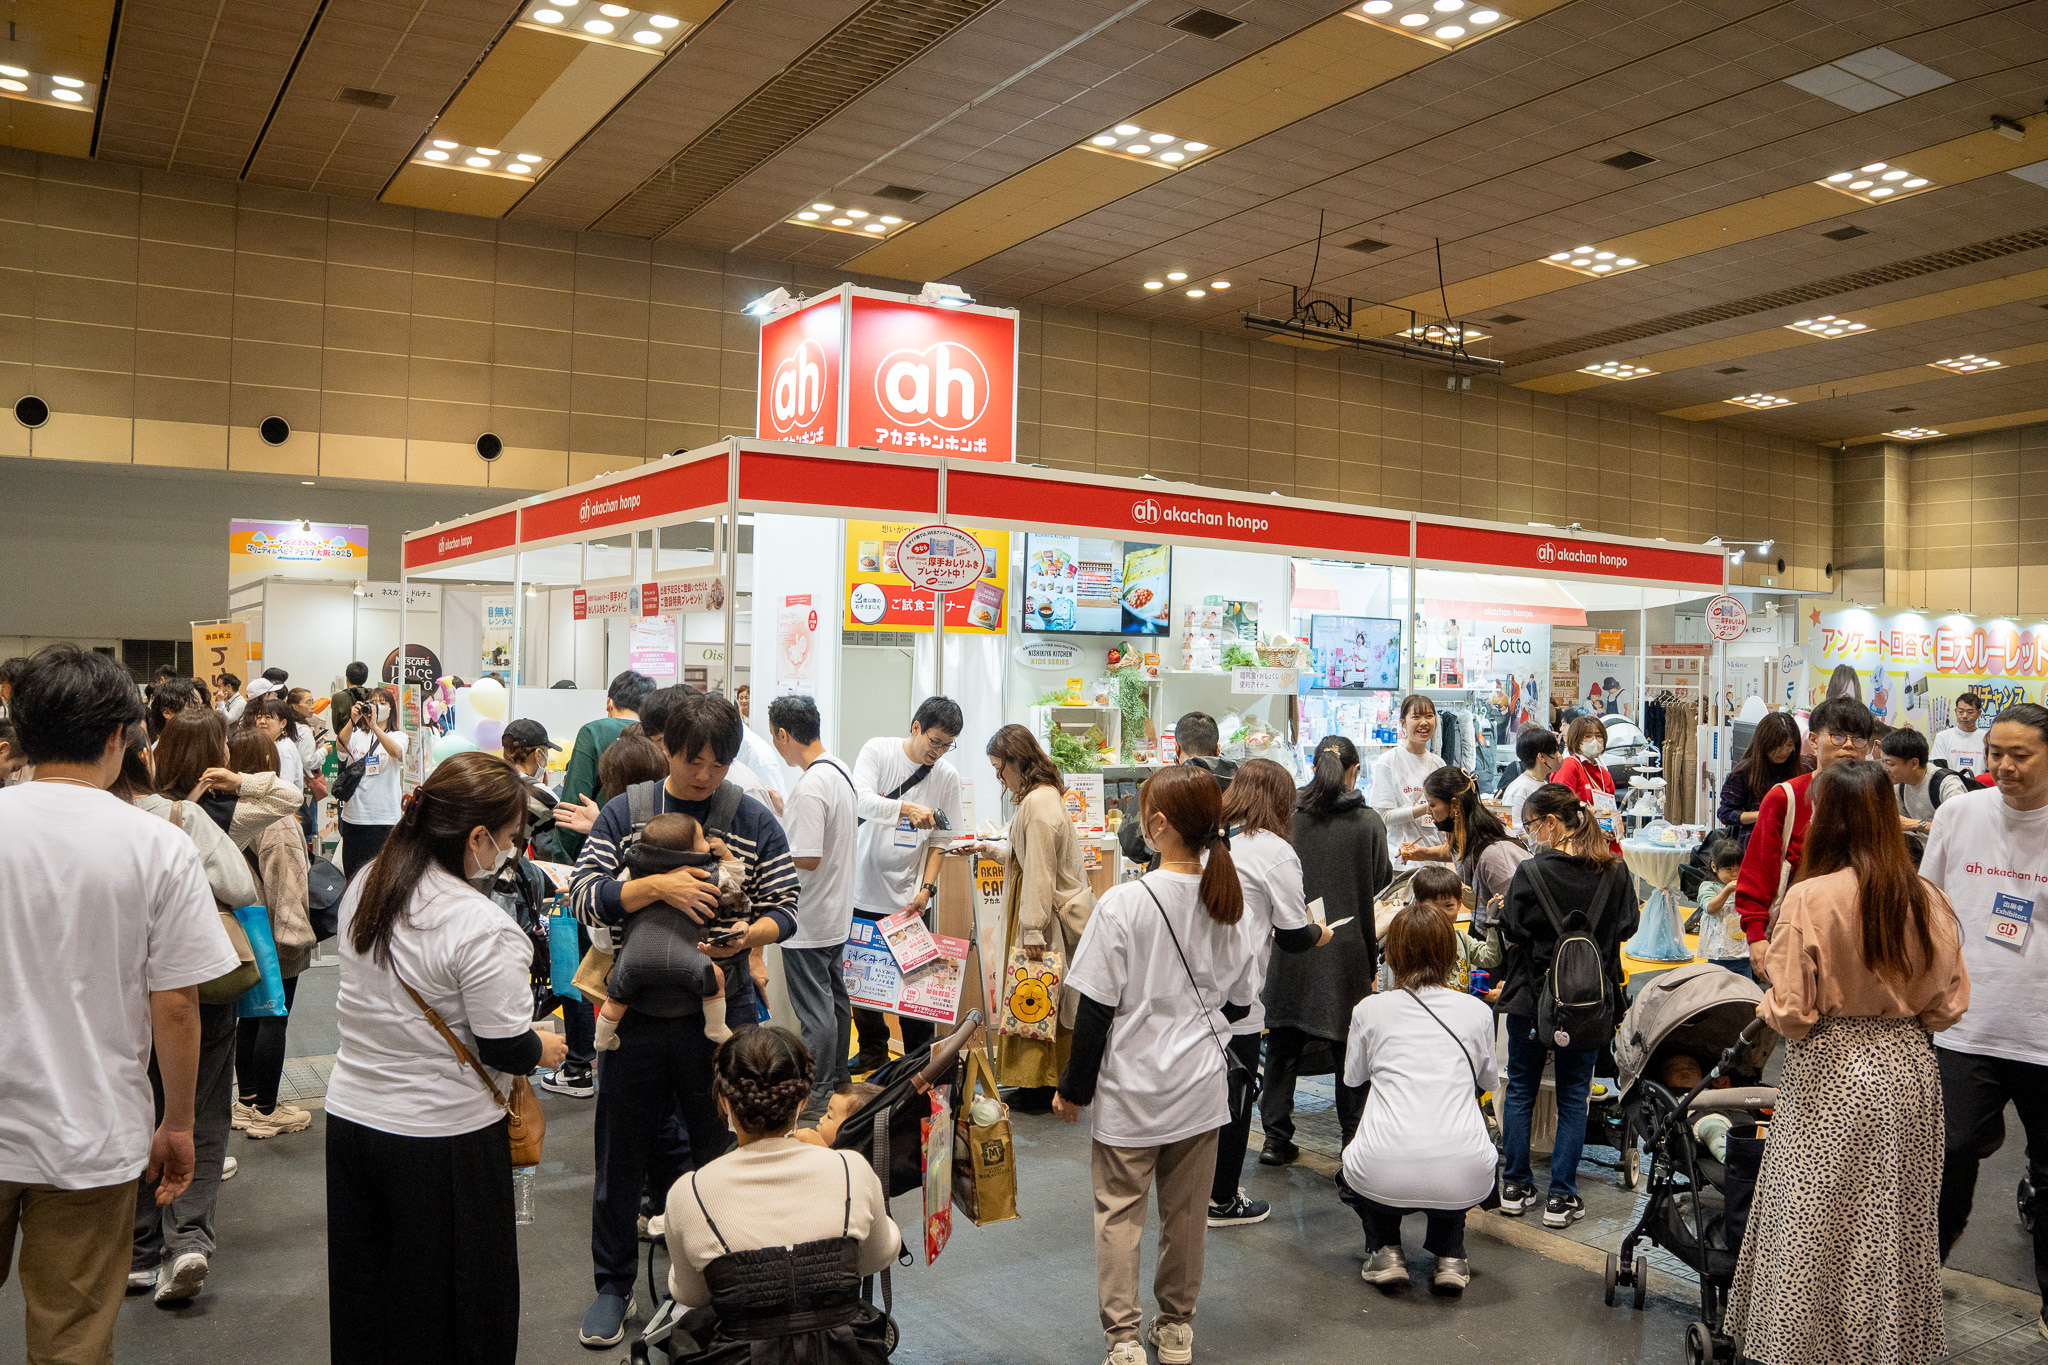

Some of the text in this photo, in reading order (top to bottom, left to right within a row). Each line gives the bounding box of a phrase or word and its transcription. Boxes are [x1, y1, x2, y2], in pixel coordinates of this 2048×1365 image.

[775, 343, 819, 421] ah
[884, 344, 975, 421] ah
[875, 427, 987, 453] アカチャンホンポ
[580, 494, 641, 521] ah akachan honpo
[1133, 499, 1269, 533] ah akachan honpo
[445, 538, 461, 551] akachan
[460, 534, 472, 548] honpo
[928, 556, 979, 570] 厚手おしりふき
[1538, 544, 1628, 569] ah akachan honpo
[891, 598, 966, 613] ご試食コナー
[1483, 608, 1534, 619] akachan honpo
[1502, 626, 1523, 635] Combi
[1492, 634, 1531, 655] Lotta
[1053, 650, 1073, 658] KITCHEN
[1403, 786, 1413, 794] ah
[1965, 862, 1983, 875] ah
[1986, 866, 2031, 881] akachan
[1995, 907, 2028, 921] Exhibitors
[1997, 922, 2018, 936] ah
